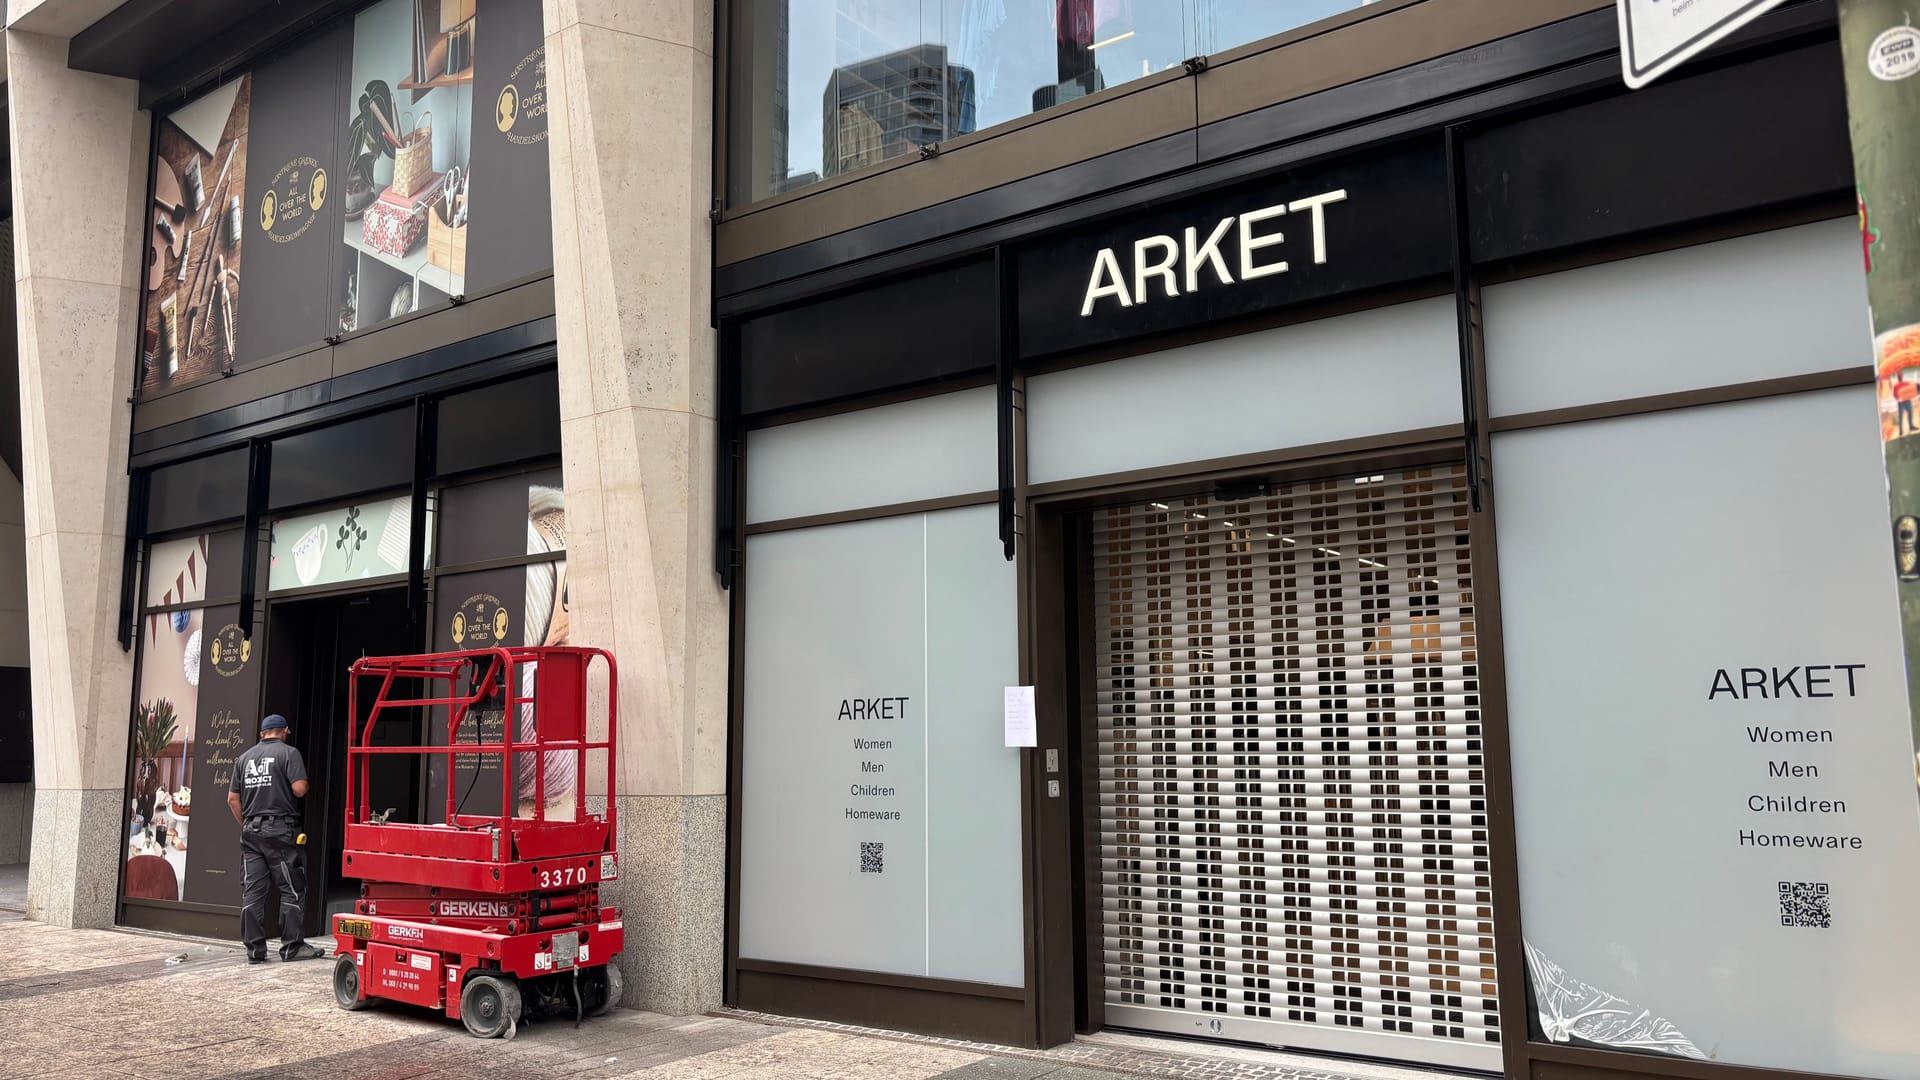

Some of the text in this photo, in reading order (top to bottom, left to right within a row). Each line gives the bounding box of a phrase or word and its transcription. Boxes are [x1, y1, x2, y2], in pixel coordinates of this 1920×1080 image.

[522, 93, 542, 108] OVER
[279, 193, 308, 212] OVER THE
[282, 206, 303, 221] WORLD
[1080, 188, 1348, 317] ARKET
[467, 624, 481, 632] OVER
[470, 632, 488, 640] WORLD
[1708, 664, 1866, 700] ARKET
[838, 697, 909, 720] ARKET
[1746, 726, 1833, 743] Women
[853, 738, 892, 750] Women
[861, 761, 884, 773] Men
[1768, 761, 1818, 777] Men
[850, 784, 895, 796] Children
[1748, 795, 1846, 813] Children
[845, 808, 901, 820] Homeware
[1739, 829, 1863, 849] Homeware
[540, 867, 587, 888] 3370
[440, 901, 500, 917] GERKEN
